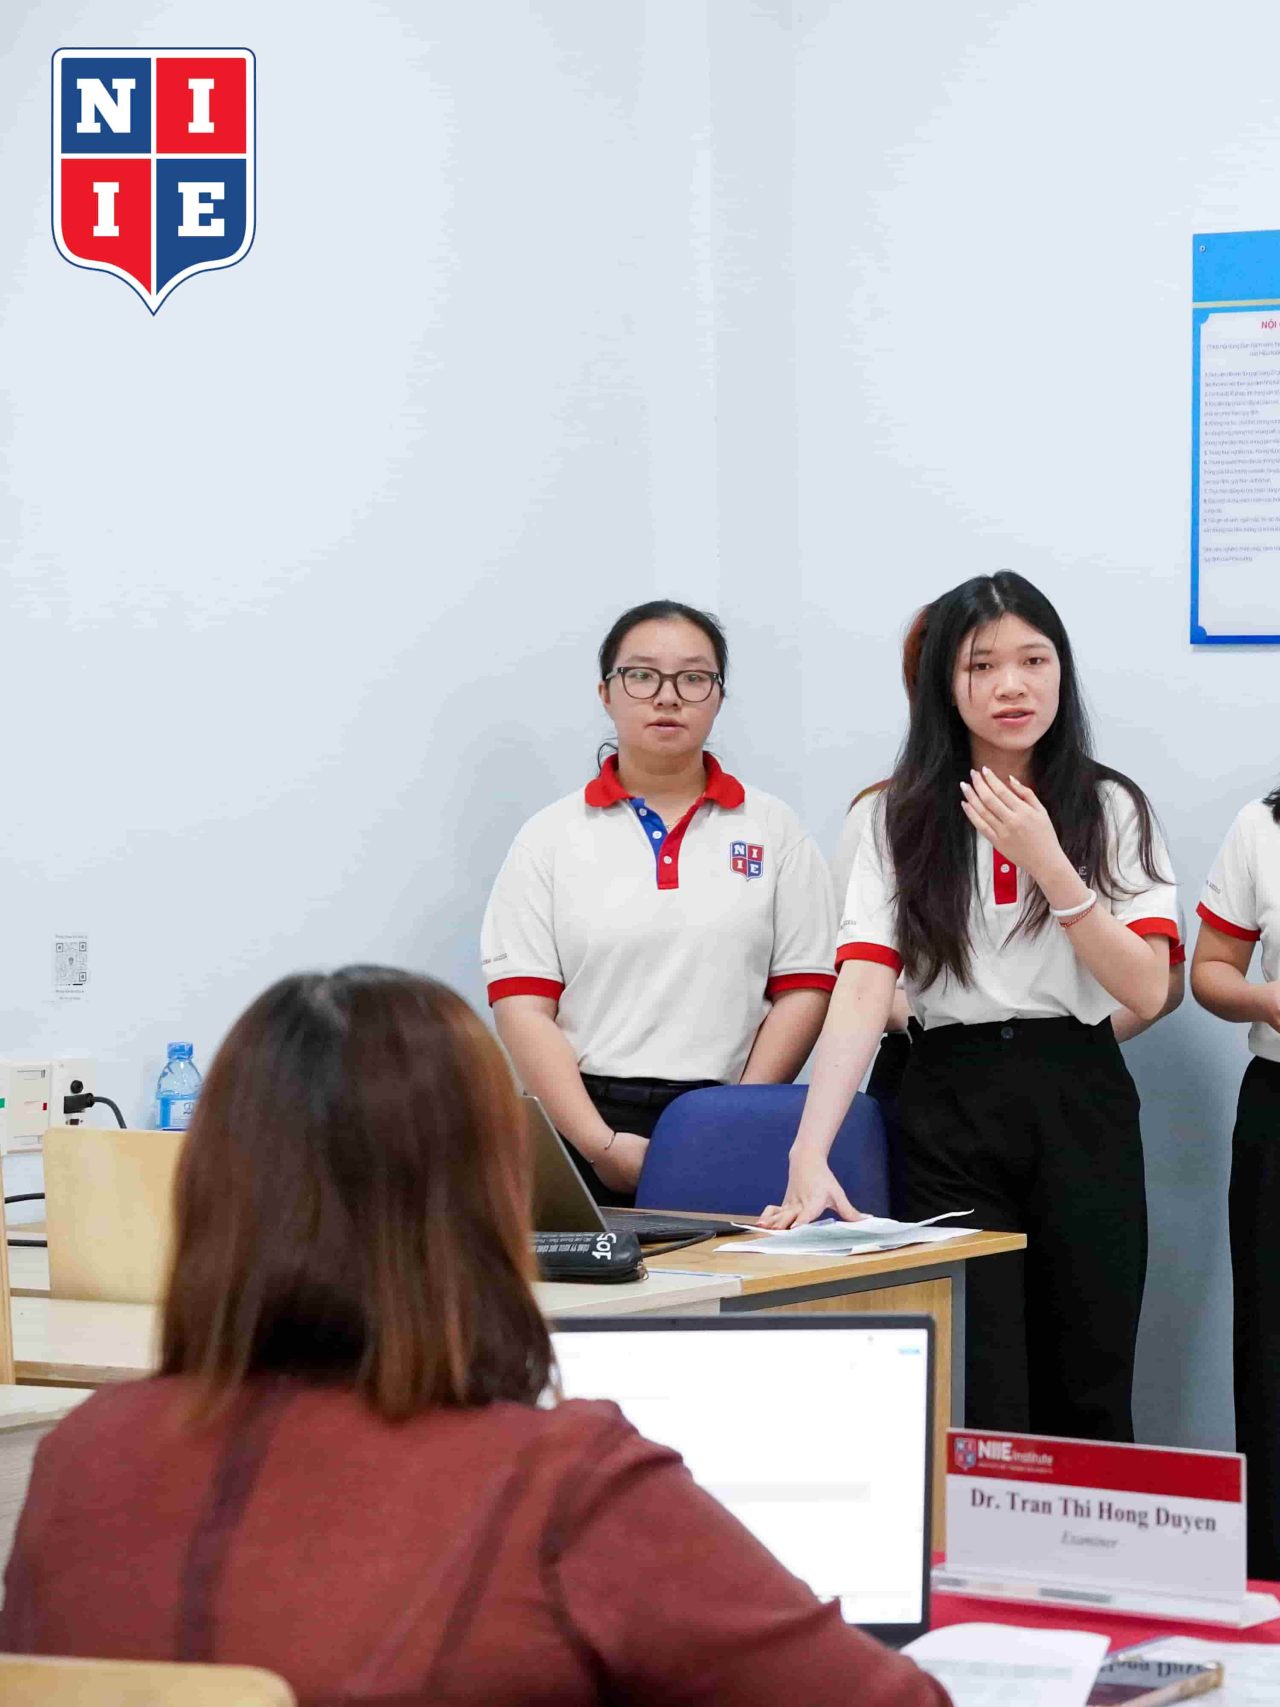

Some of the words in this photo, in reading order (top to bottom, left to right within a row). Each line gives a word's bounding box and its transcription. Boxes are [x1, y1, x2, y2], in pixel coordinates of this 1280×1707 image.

[978, 1440, 1013, 1461] NIIE
[970, 1487, 1000, 1510] Dr.
[1006, 1491, 1053, 1515] Tran
[1059, 1496, 1092, 1519] Thi
[1098, 1501, 1149, 1528] Hong
[1155, 1506, 1218, 1534] Duyen
[1060, 1529, 1119, 1549] Examiner
